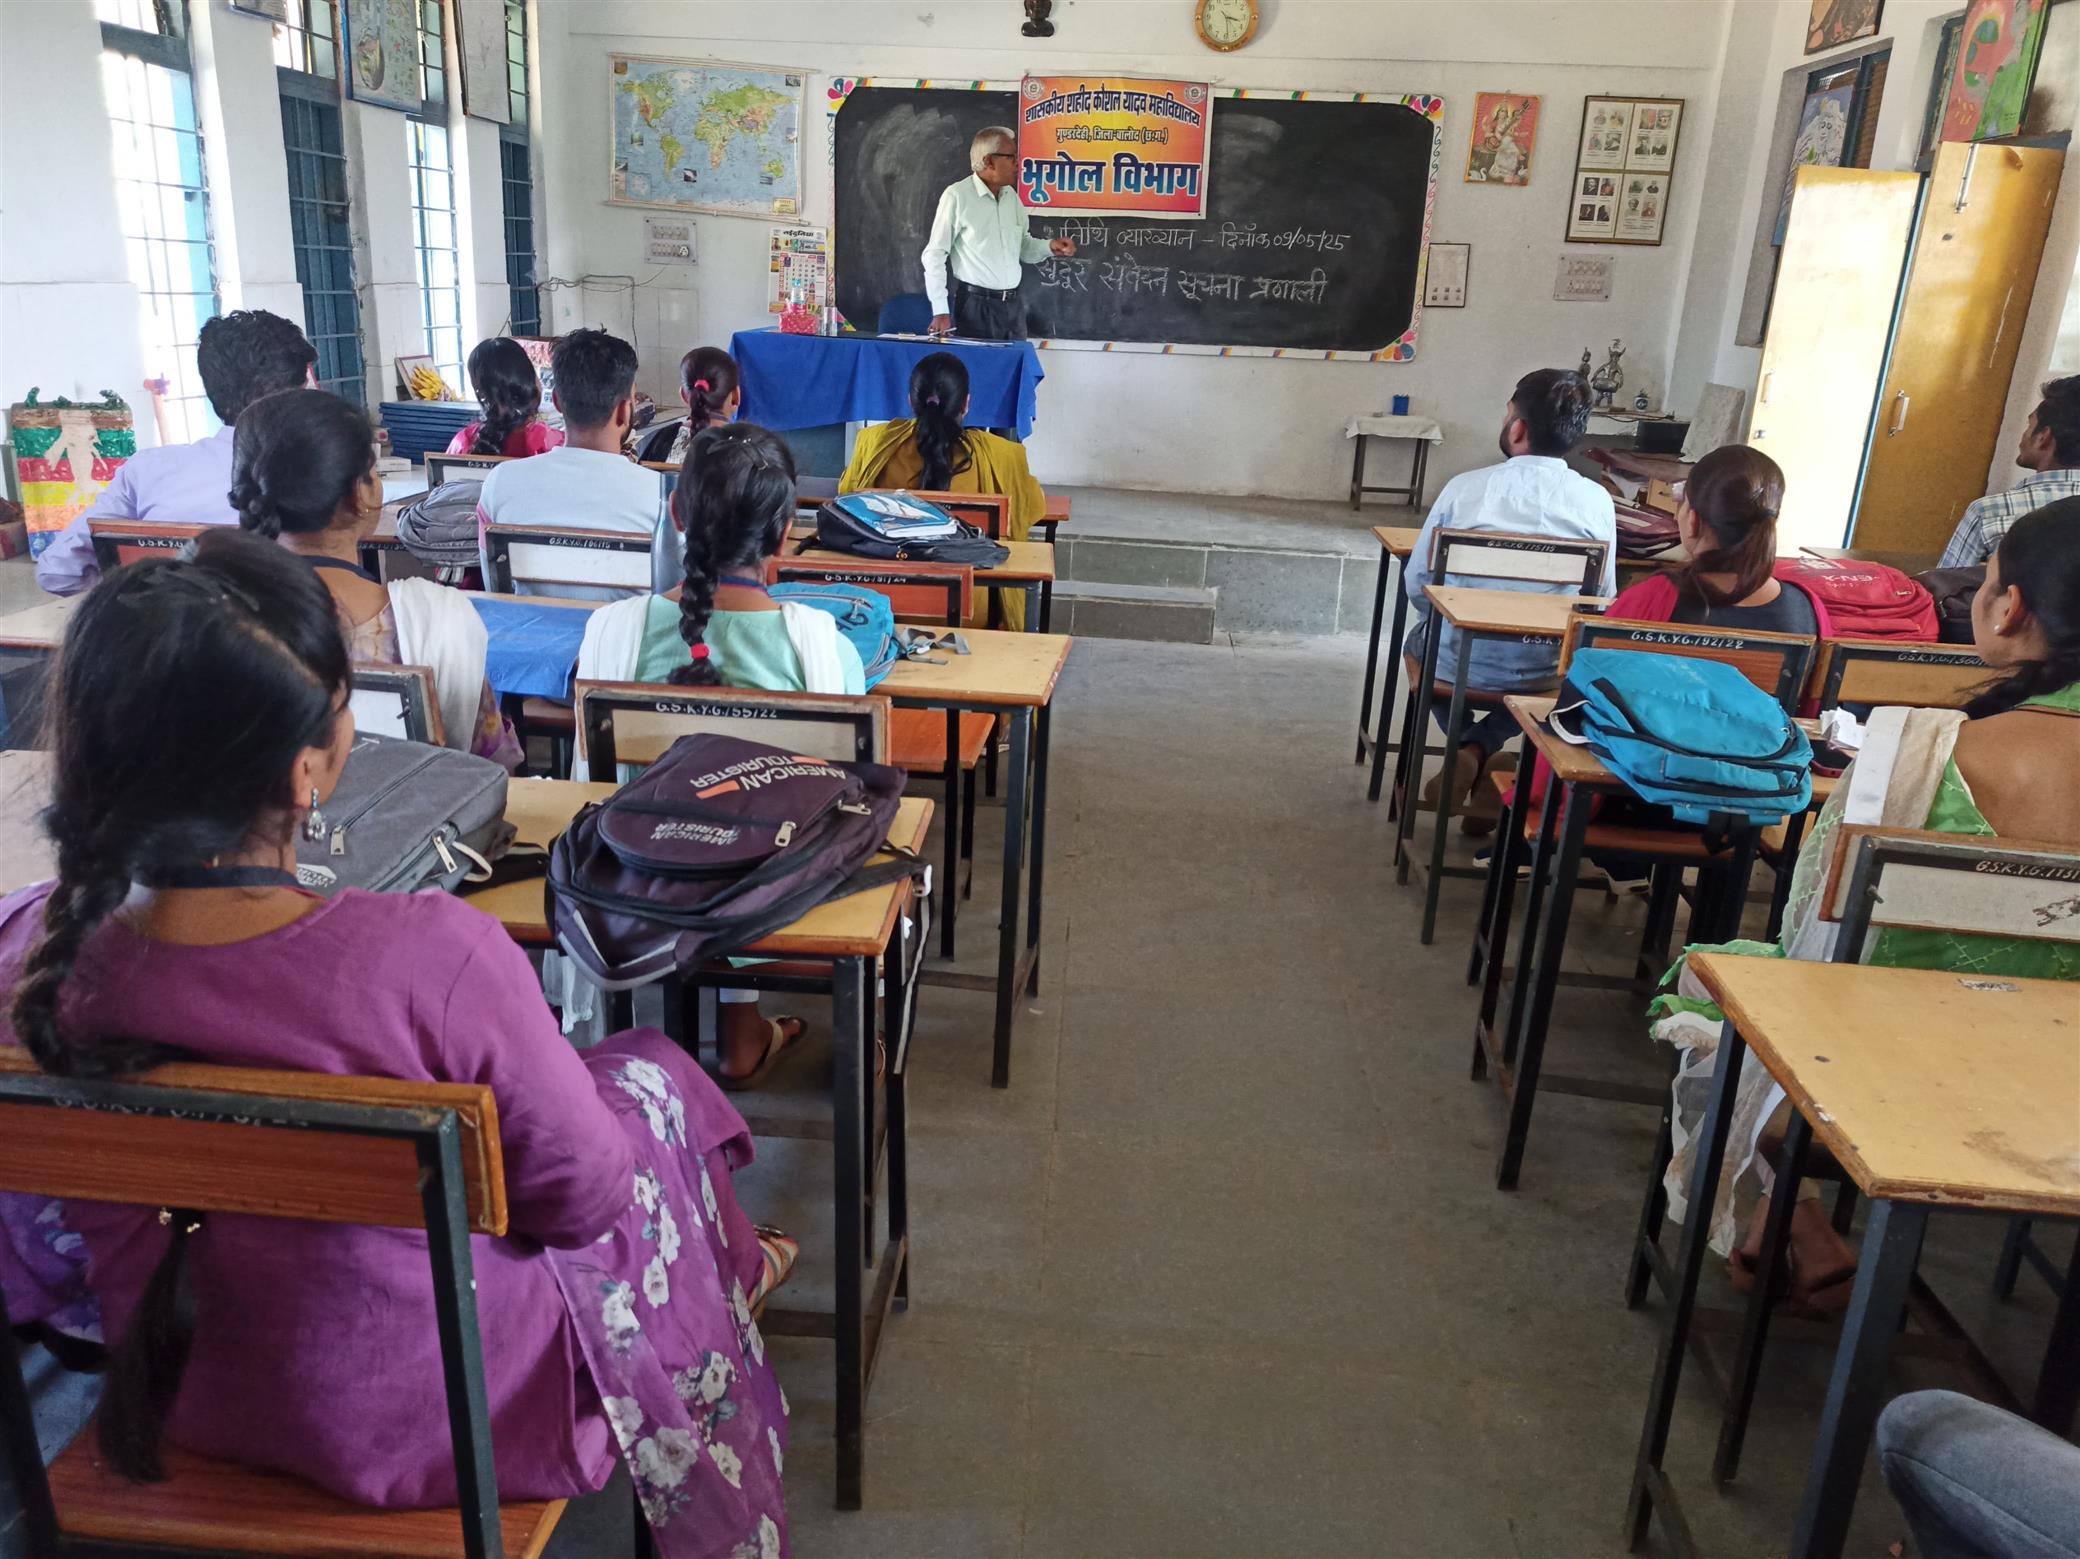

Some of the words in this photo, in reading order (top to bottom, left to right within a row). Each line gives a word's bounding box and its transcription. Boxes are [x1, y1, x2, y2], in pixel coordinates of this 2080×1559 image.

[1026, 90, 1065, 122] शासकीय
[1066, 84, 1091, 114] शहीद
[1123, 91, 1147, 116] यादव
[1022, 151, 1106, 203] भूगोल
[1113, 153, 1200, 195] विभाग
[689, 755, 797, 788] TOURISTER
[739, 765, 847, 791] AMERICAN
[650, 831, 739, 846] AMERICAN
